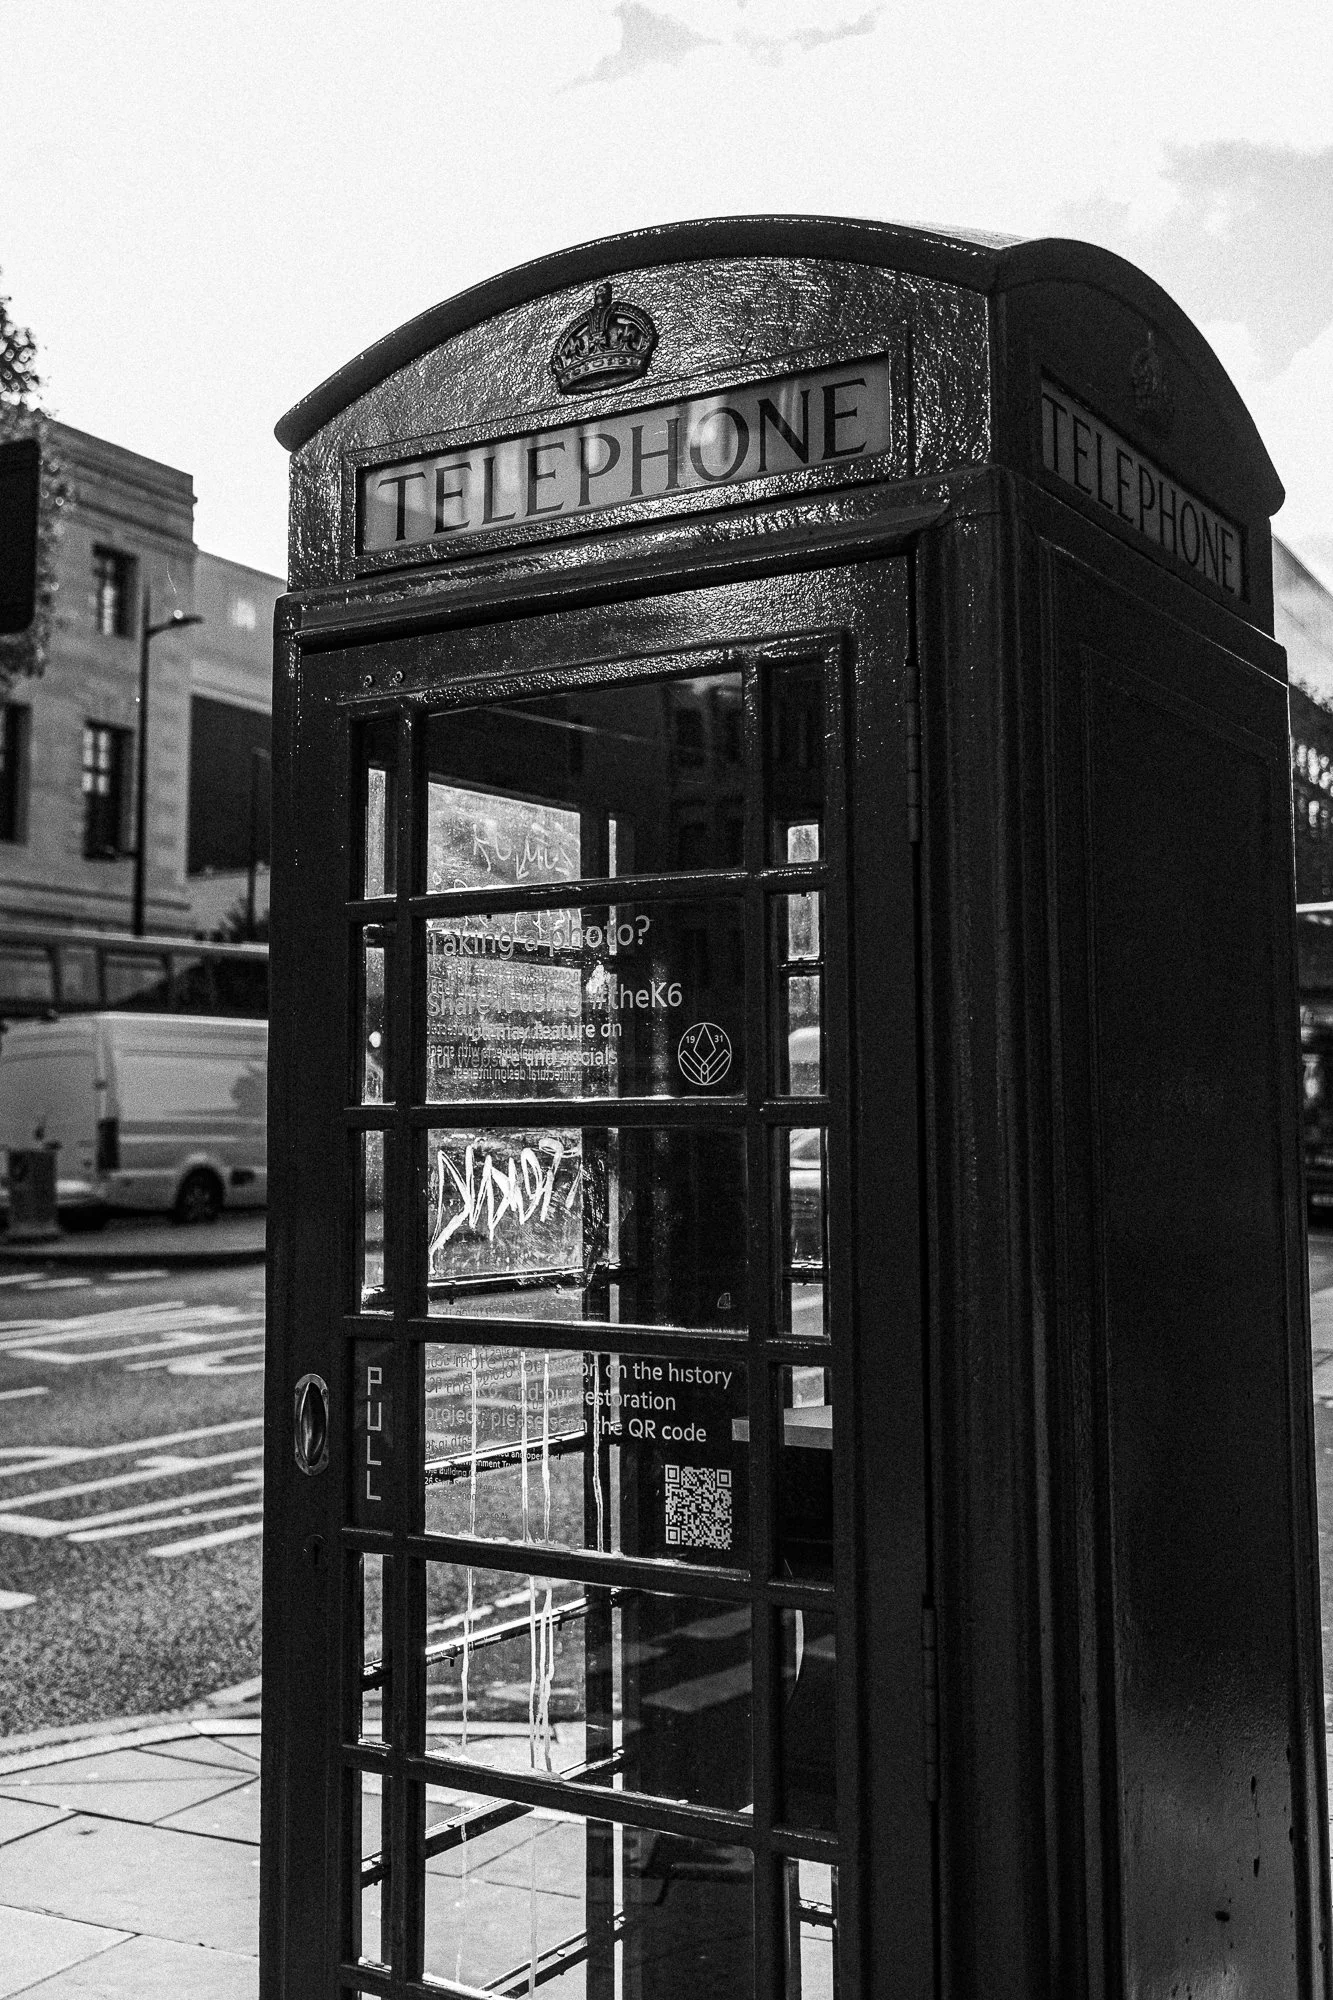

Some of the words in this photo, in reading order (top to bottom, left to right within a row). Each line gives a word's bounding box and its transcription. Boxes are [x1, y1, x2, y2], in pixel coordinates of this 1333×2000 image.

[378, 377, 868, 542] TELEPHONE
[1042, 392, 1236, 594] TELEPHONE
[427, 928, 514, 960] Taking
[524, 929, 539, 951] a
[549, 914, 650, 957] photo?
[427, 991, 491, 1017] Share
[589, 982, 682, 1010] #theK6
[600, 1022, 622, 1038] on
[685, 1035, 696, 1044] 19
[714, 1034, 724, 1043] 31
[605, 1362, 627, 1379] on
[632, 1361, 663, 1381] the
[668, 1362, 733, 1390] history
[580, 1391, 677, 1411] restoration
[366, 1366, 383, 1501] PULL
[491, 1408, 545, 1430] please
[628, 1418, 656, 1439] QR
[661, 1422, 707, 1442] code
